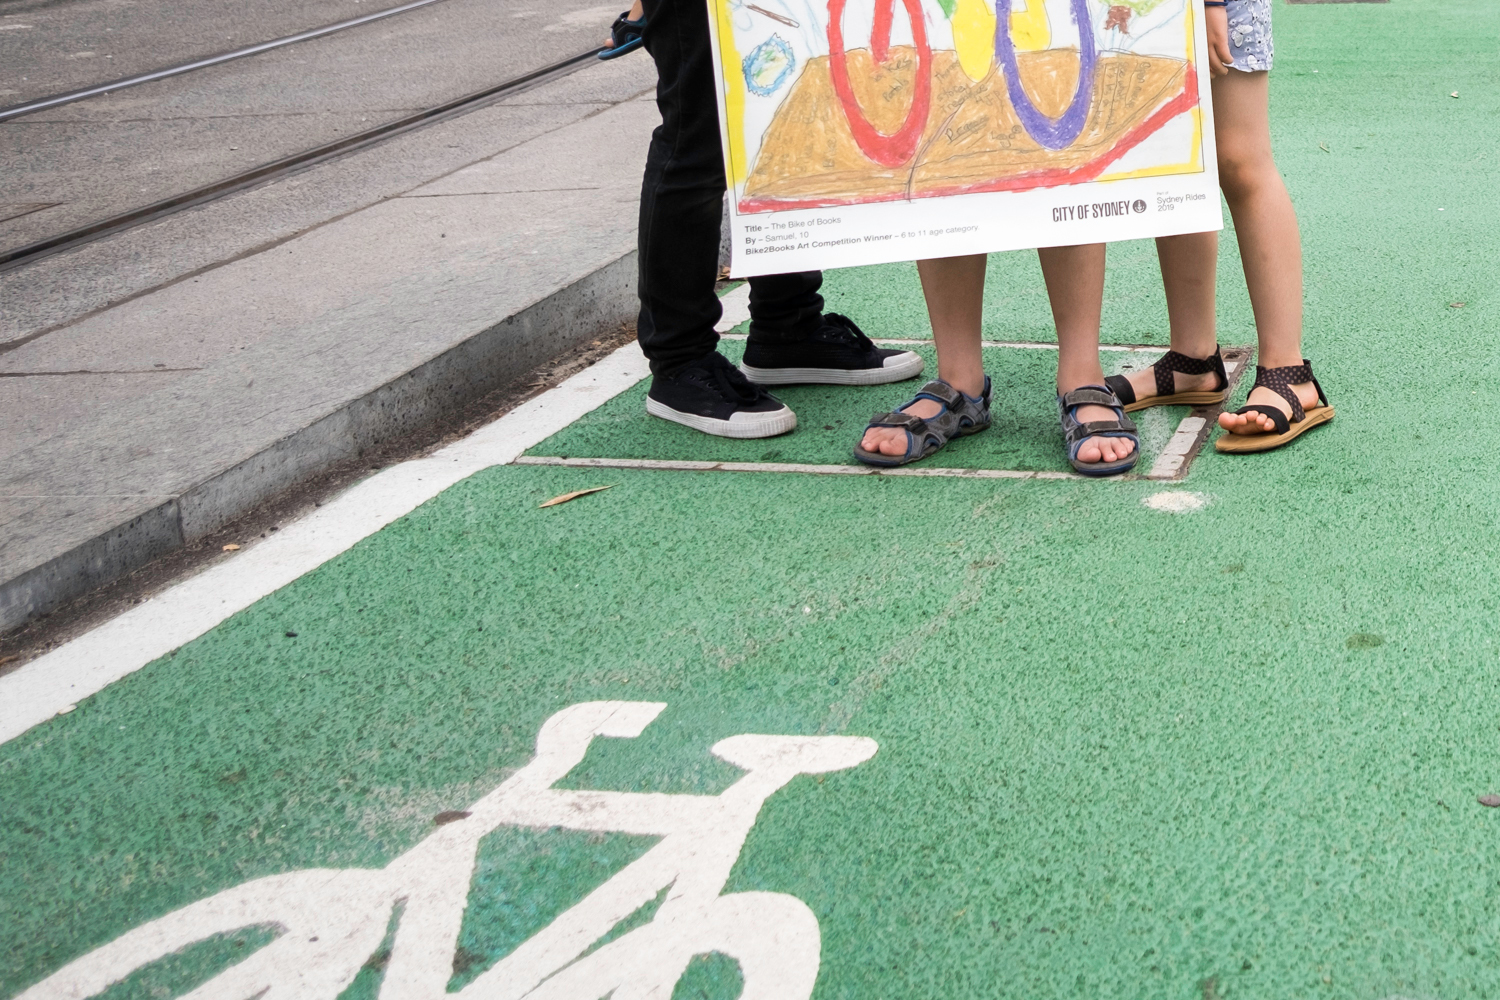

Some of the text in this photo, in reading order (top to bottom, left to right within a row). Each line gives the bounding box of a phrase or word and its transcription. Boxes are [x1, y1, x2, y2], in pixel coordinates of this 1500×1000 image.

[1157, 193, 1206, 204] Sydney Rides
[1052, 200, 1131, 223] CITY OF SYDNEY
[1158, 204, 1175, 212] 2019
[744, 225, 762, 233] Title
[771, 222, 786, 230] The
[788, 220, 805, 229] Bike
[807, 218, 816, 227] of
[816, 216, 842, 226] Books
[745, 237, 756, 246] By
[765, 232, 797, 243] Samuel,
[799, 231, 809, 239] 10
[745, 244, 795, 255] Bike2Books
[797, 241, 810, 250] Art
[811, 236, 861, 249] Competition
[863, 233, 893, 243] Winner
[918, 229, 927, 237] 11
[929, 228, 944, 237] age
